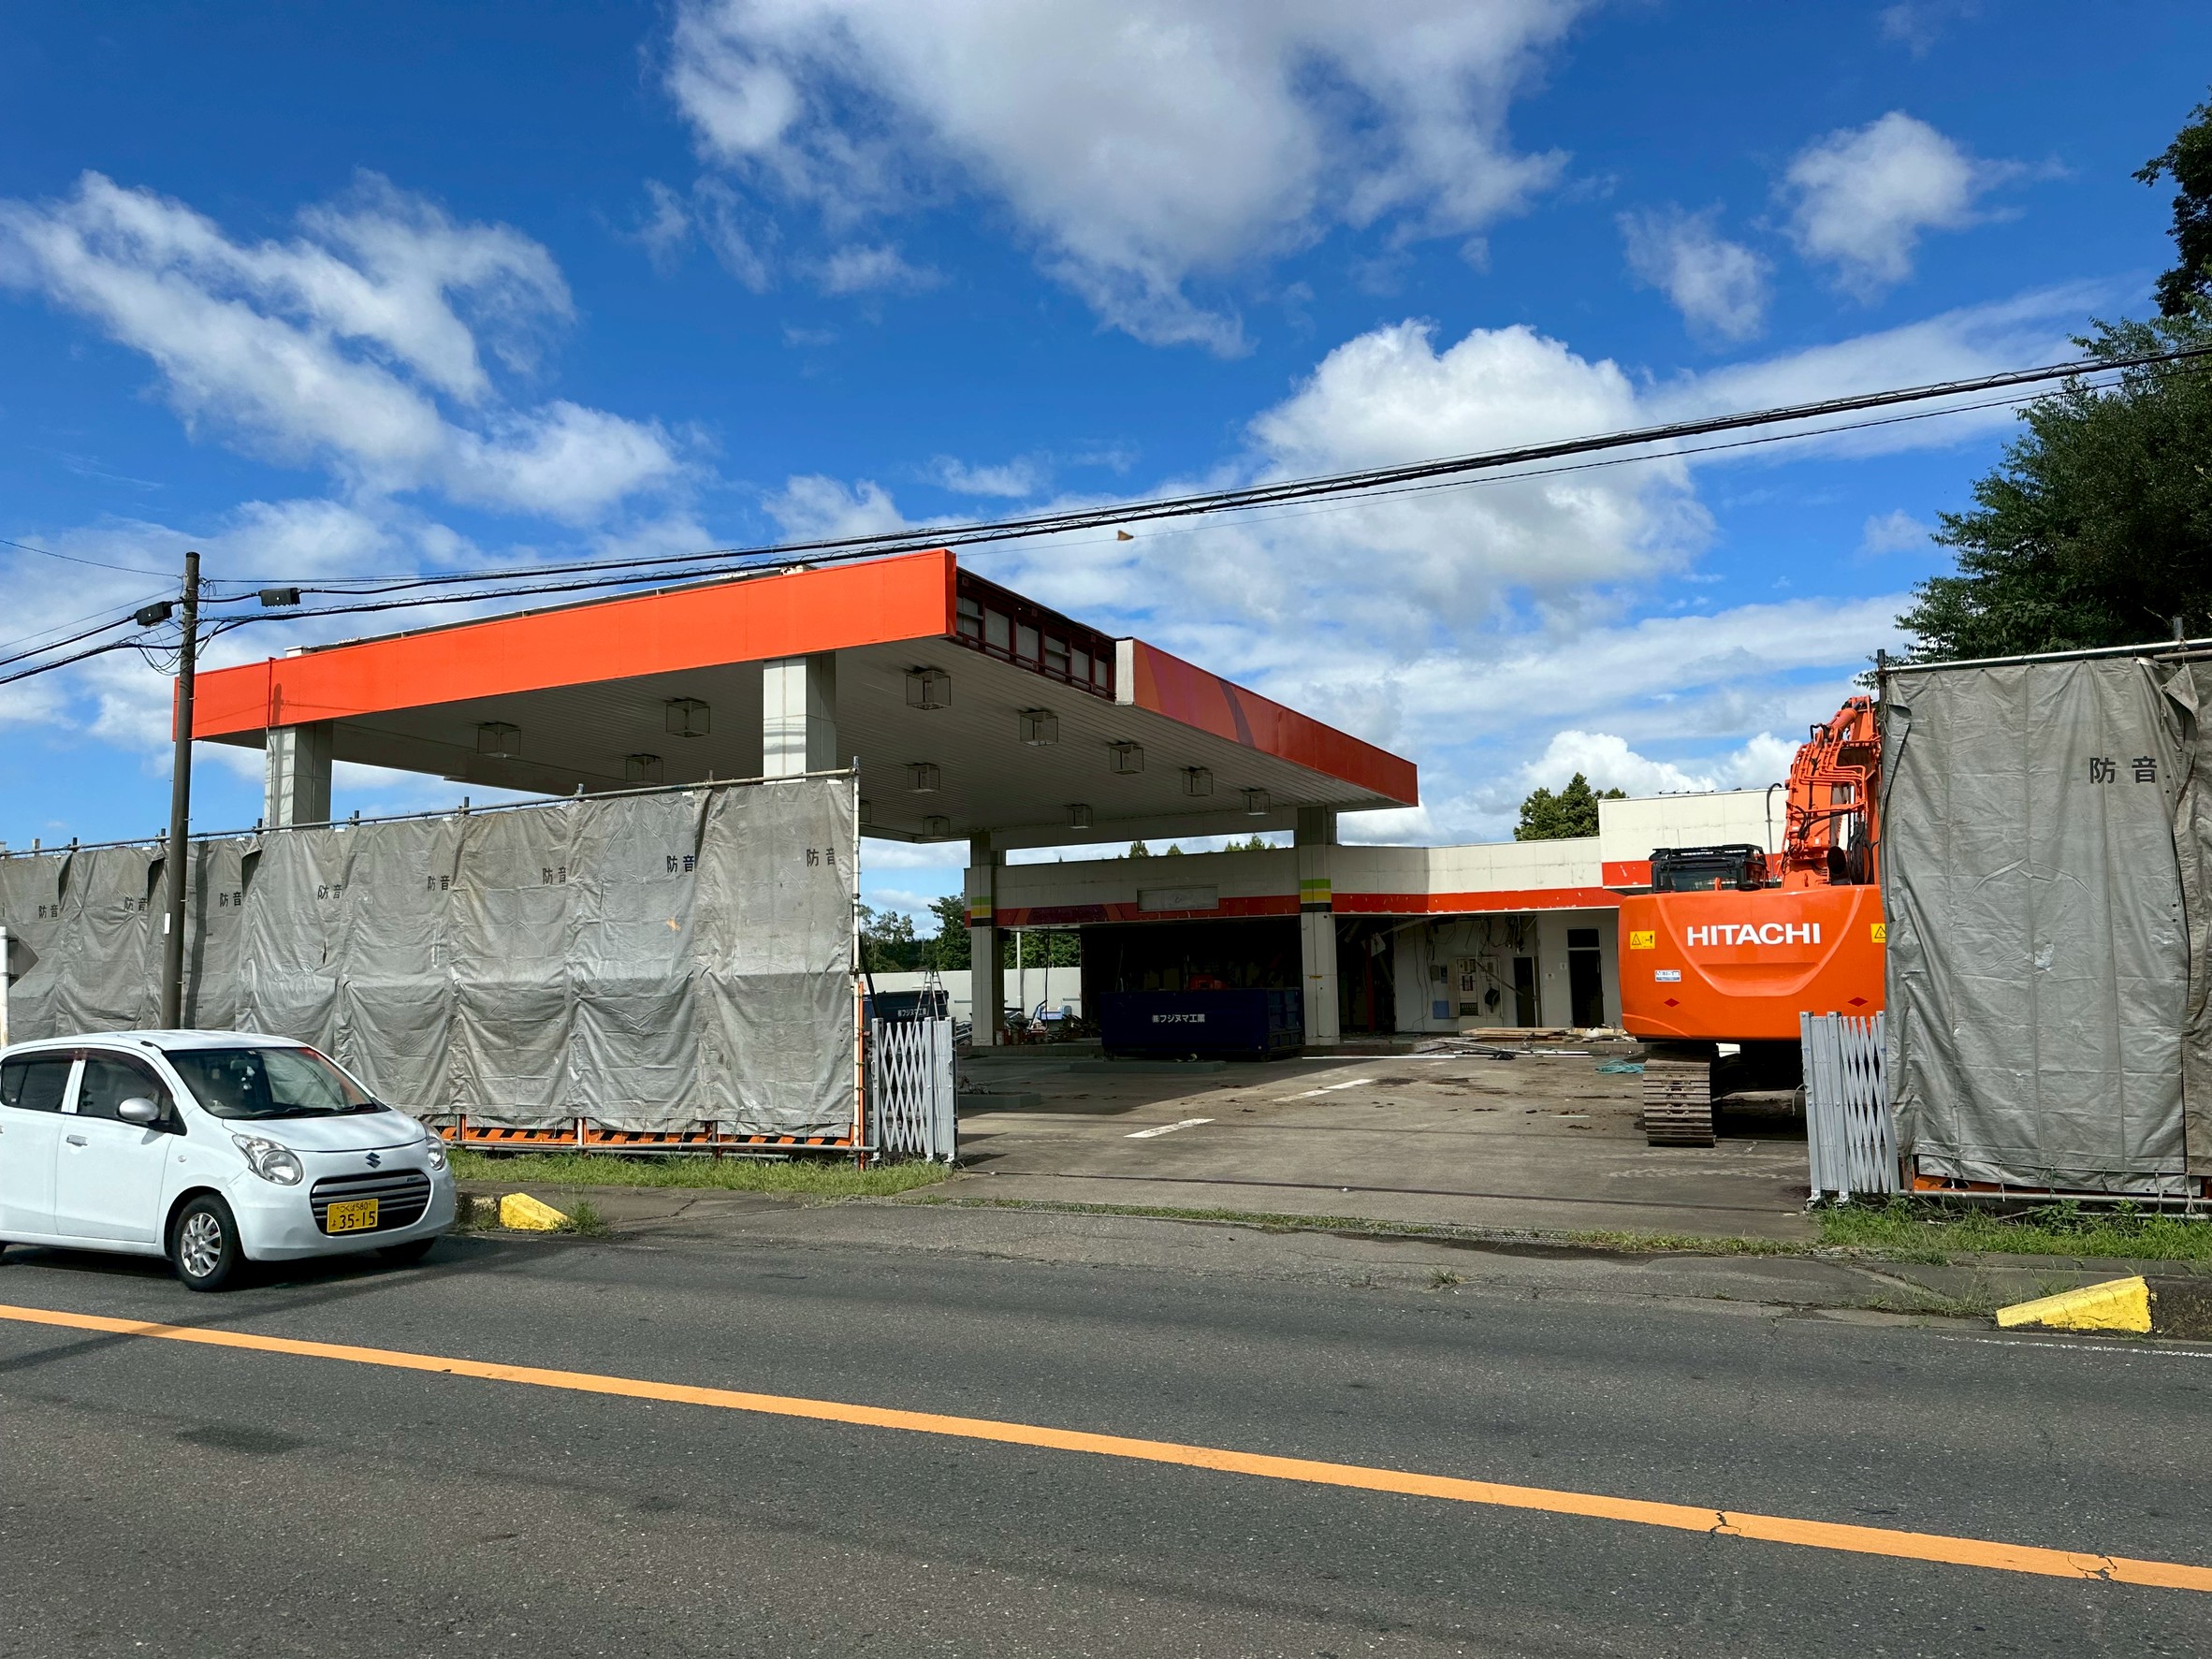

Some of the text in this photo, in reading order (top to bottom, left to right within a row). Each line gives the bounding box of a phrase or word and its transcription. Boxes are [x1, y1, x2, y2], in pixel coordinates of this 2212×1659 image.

[2089, 756, 2157, 783] 防音
[666, 854, 695, 873] 防音
[807, 847, 836, 866] 防音
[427, 875, 451, 892] 防音
[542, 866, 567, 885] 防音
[219, 891, 242, 908] 防音
[317, 884, 342, 900] 防音
[38, 904, 59, 919] 防音
[124, 896, 148, 911] 防音
[1687, 923, 1821, 947] HITACHI
[339, 1211, 376, 1230] 35-15
